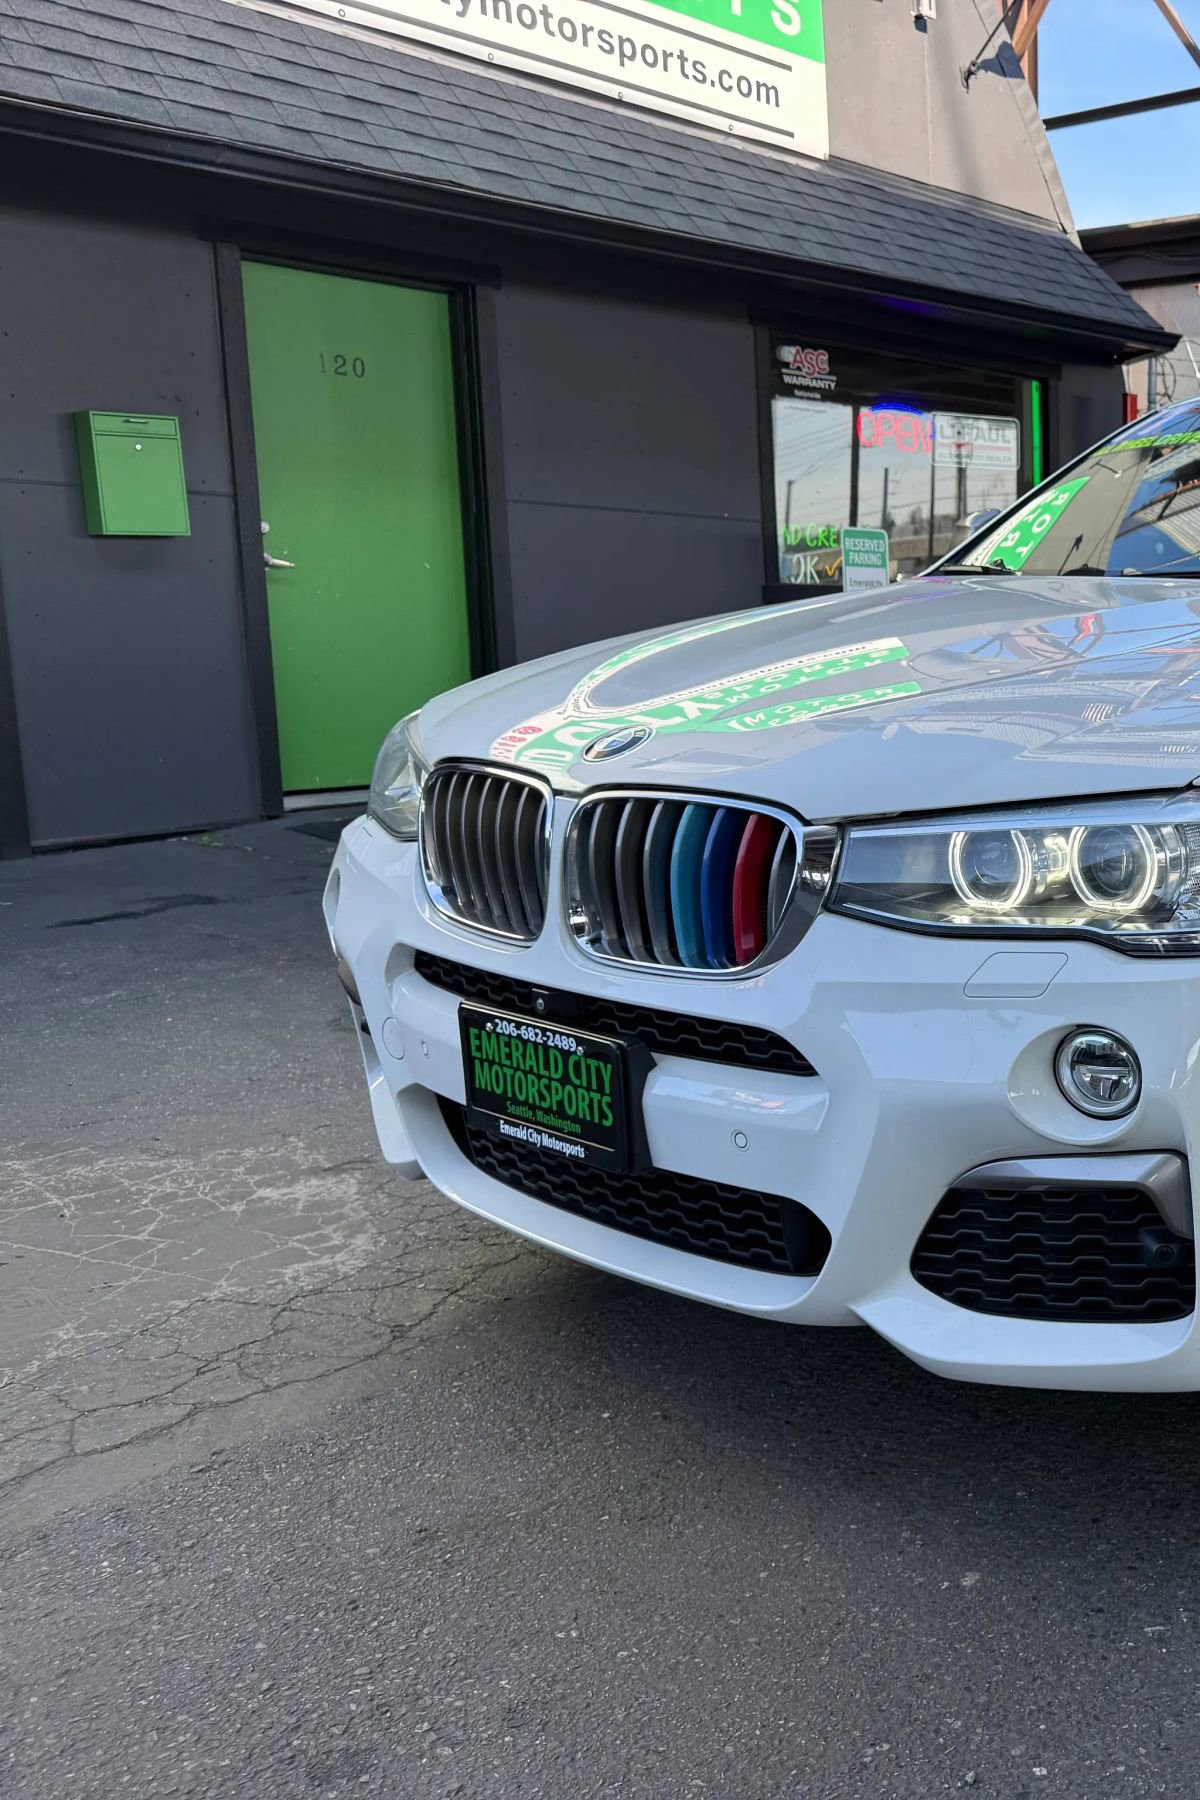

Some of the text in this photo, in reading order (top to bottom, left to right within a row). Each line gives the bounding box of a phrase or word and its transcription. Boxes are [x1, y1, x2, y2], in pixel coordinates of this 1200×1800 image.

[320, 353, 365, 378] 120
[790, 346, 829, 378] ASC
[782, 375, 836, 390] WARRANTY
[856, 411, 932, 454] OPEN
[805, 521, 839, 548] CRE
[845, 537, 885, 553] RESERVED
[848, 552, 882, 566] PARKING
[494, 1018, 577, 1052] 206-682-2489
[469, 1027, 613, 1094] EMERALD CITY
[474, 1059, 613, 1127] MOTORSPORTS
[506, 1101, 581, 1134] Seattle, Washington
[500, 1119, 585, 1159] Emerald City Motorsports
